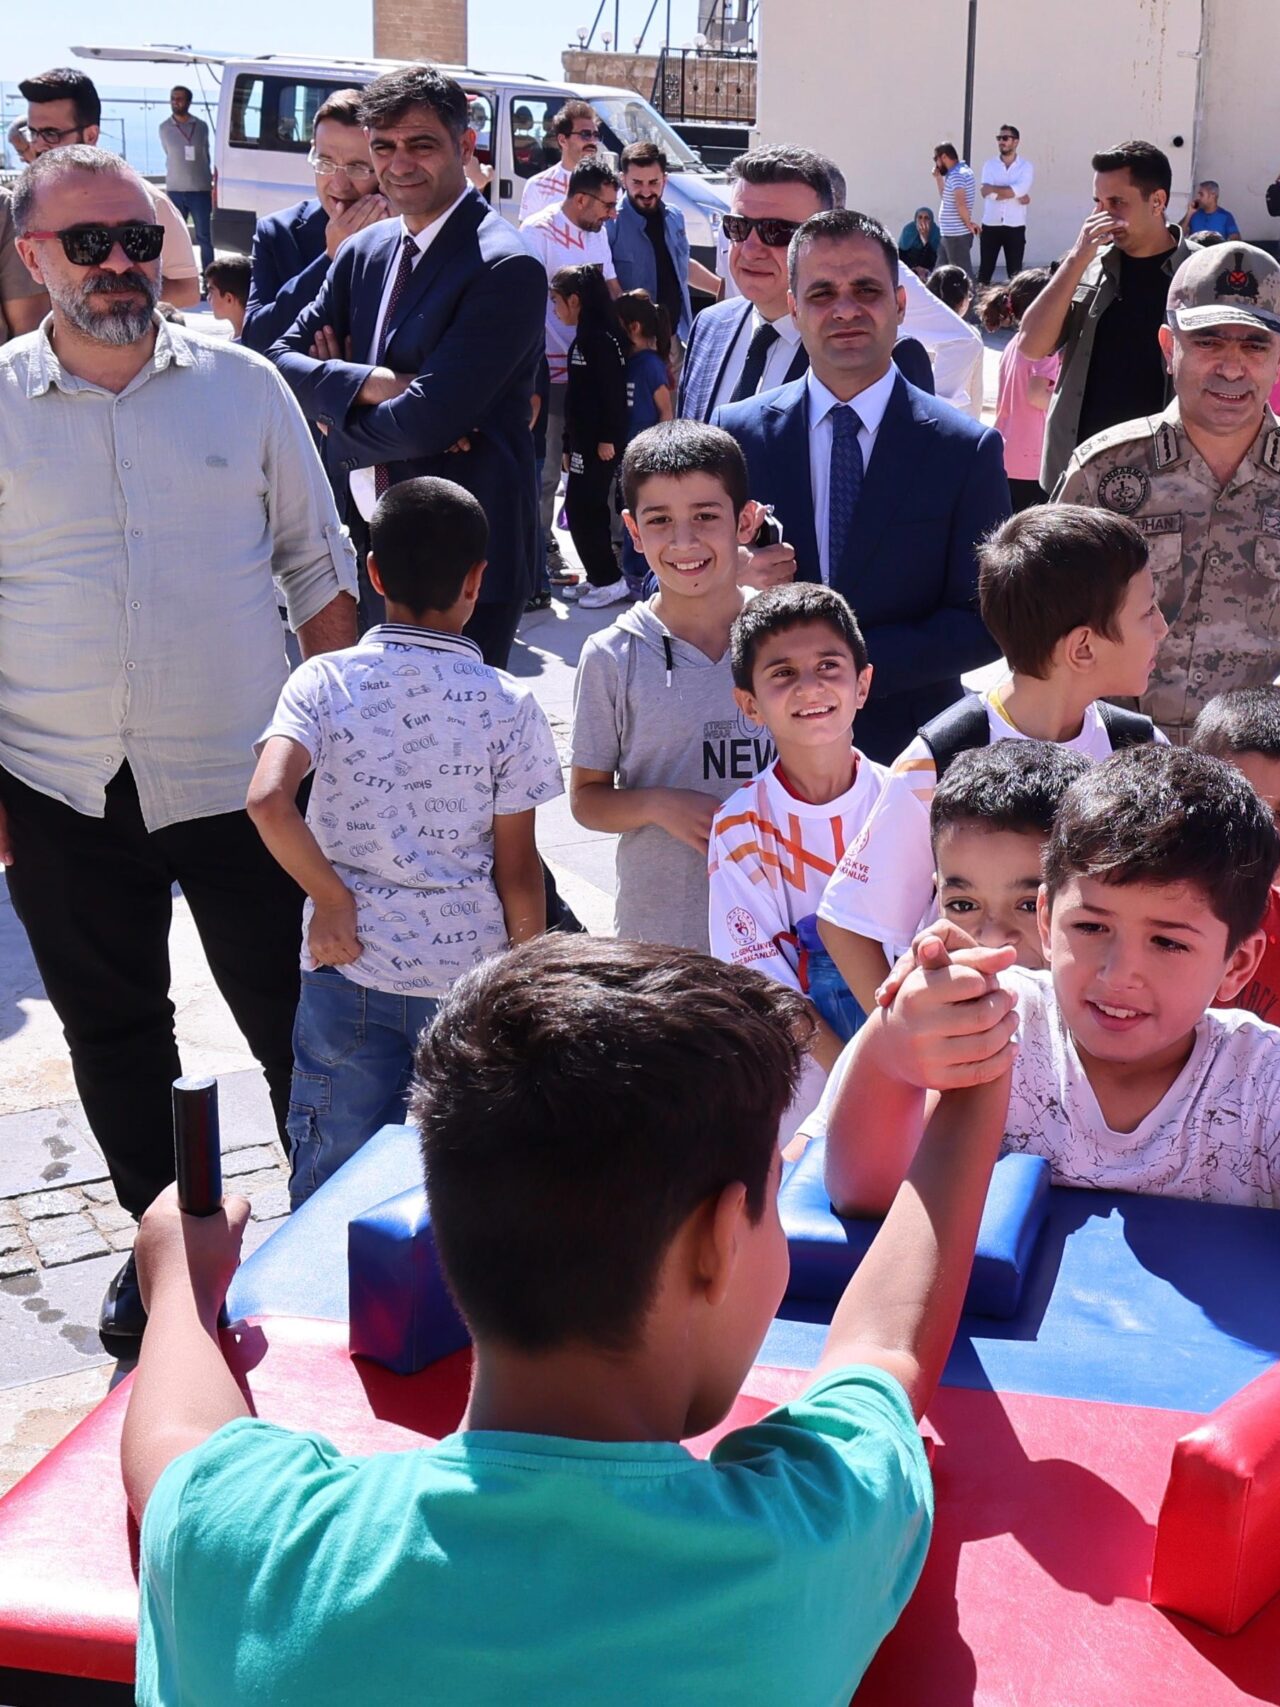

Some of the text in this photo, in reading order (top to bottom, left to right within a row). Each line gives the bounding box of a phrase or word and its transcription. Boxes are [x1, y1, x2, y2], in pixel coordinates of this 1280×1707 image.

[360, 680, 392, 692] Skate
[442, 689, 487, 702] CITY
[360, 697, 397, 720] COOL
[402, 713, 431, 730] Fun
[402, 733, 439, 754] COOL
[703, 739, 778, 780] NEW
[439, 763, 484, 777] CITY
[353, 771, 395, 794] CITY
[526, 781, 549, 801] Fun
[424, 797, 468, 813] COOL
[346, 821, 376, 832] Skate
[417, 825, 460, 840] CITY
[349, 839, 382, 858] COOL
[392, 850, 420, 869] Fun
[354, 881, 399, 900] CITY
[440, 900, 481, 917] COOL
[431, 930, 478, 946] CITY
[391, 955, 423, 972] Fun
[393, 975, 434, 993] COOL
